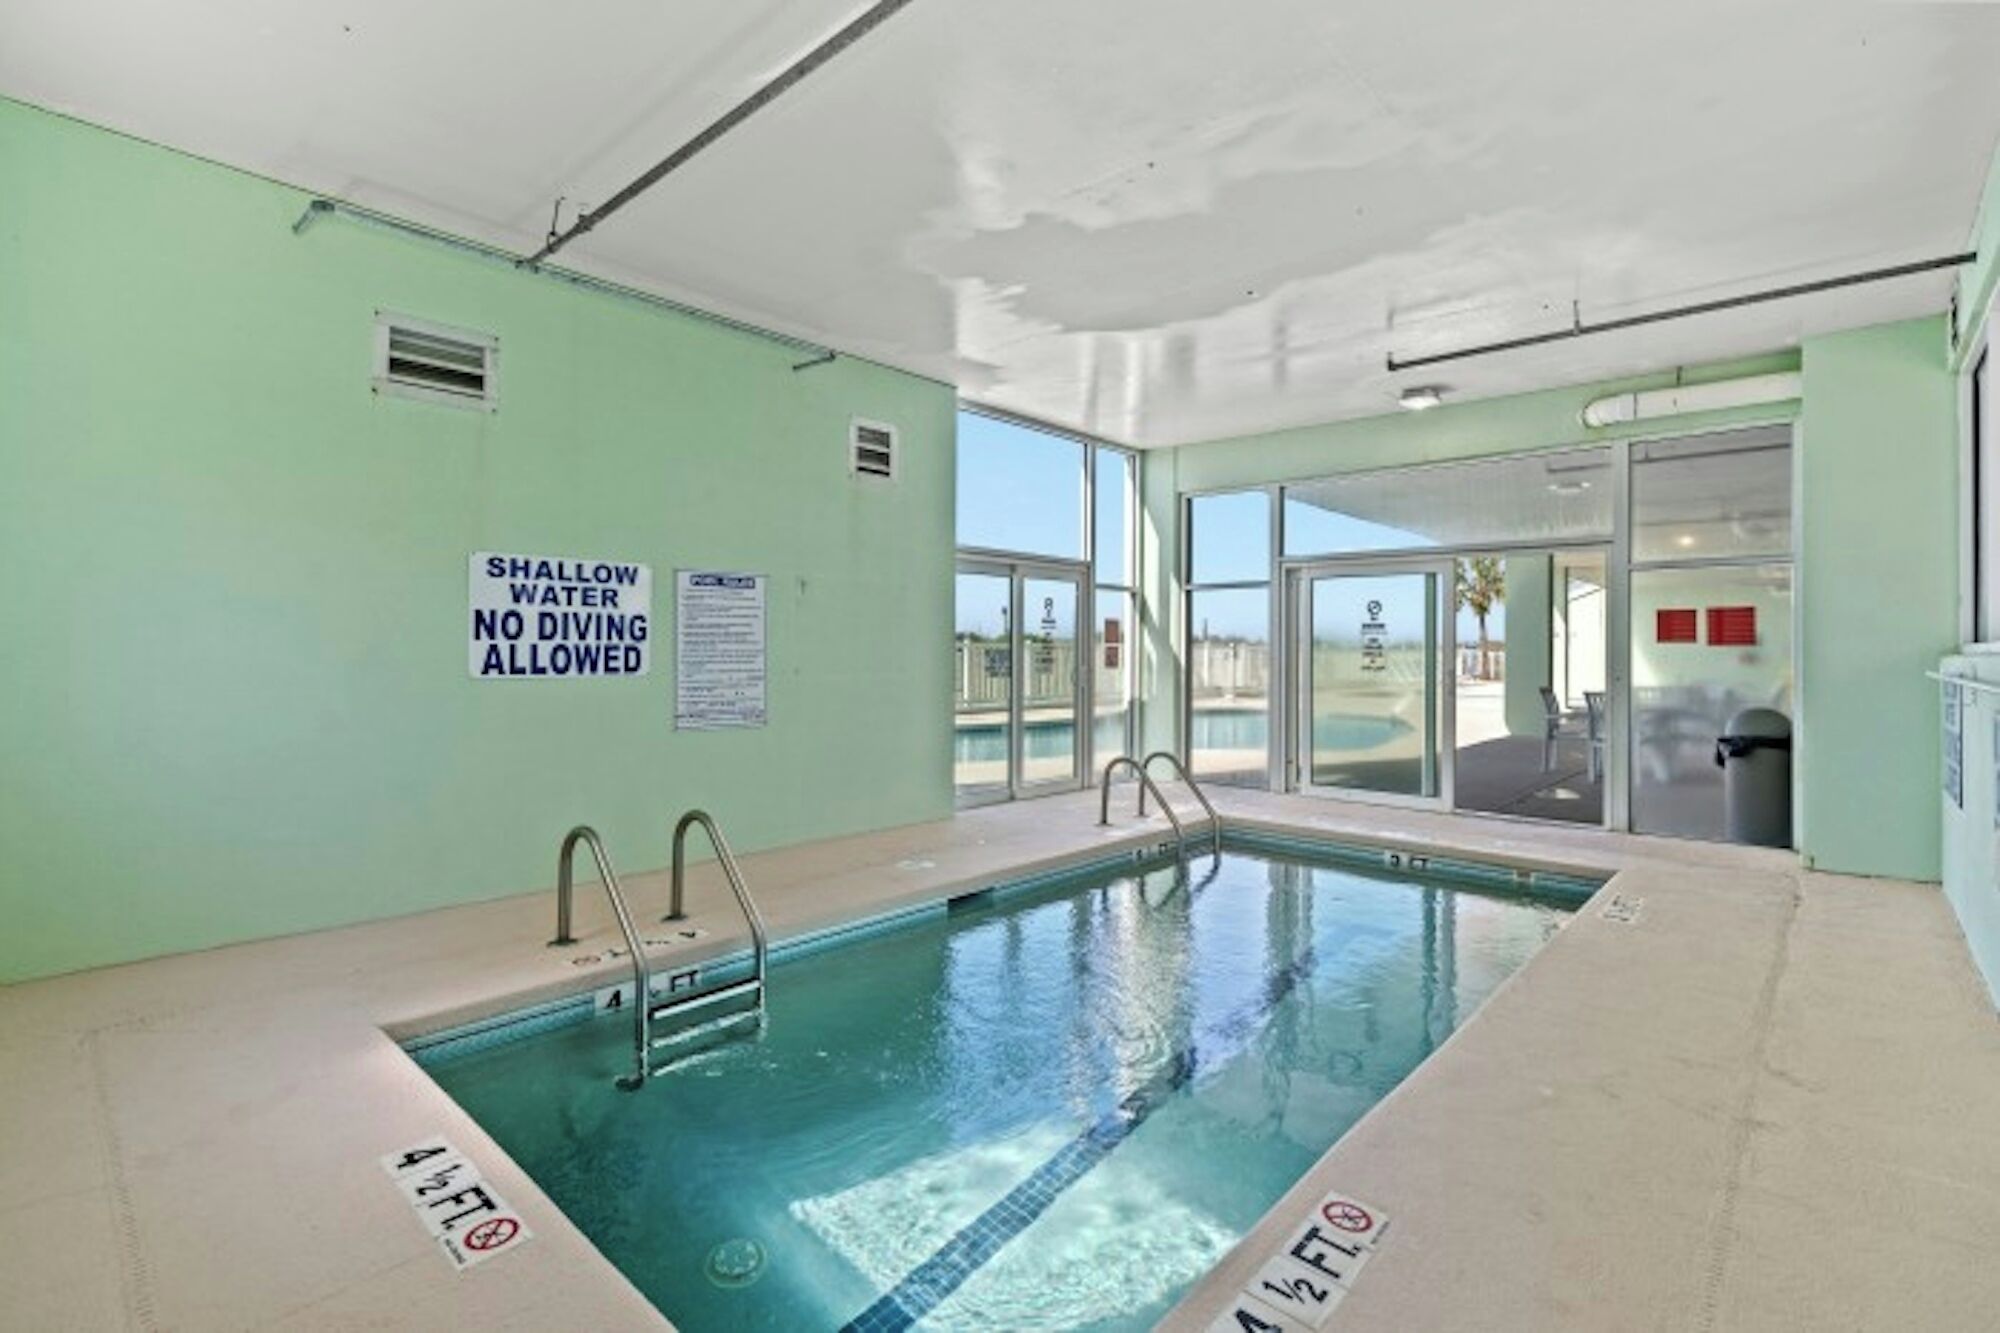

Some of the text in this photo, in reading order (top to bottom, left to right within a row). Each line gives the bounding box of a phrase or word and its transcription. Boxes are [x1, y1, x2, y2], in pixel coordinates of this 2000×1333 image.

[486, 557, 638, 586] SHALLOW
[509, 583, 618, 608] WATER
[474, 609, 647, 643] NO DIVING
[481, 643, 642, 675] ALLOWED
[670, 969, 699, 992] FT
[397, 1147, 447, 1170] 4
